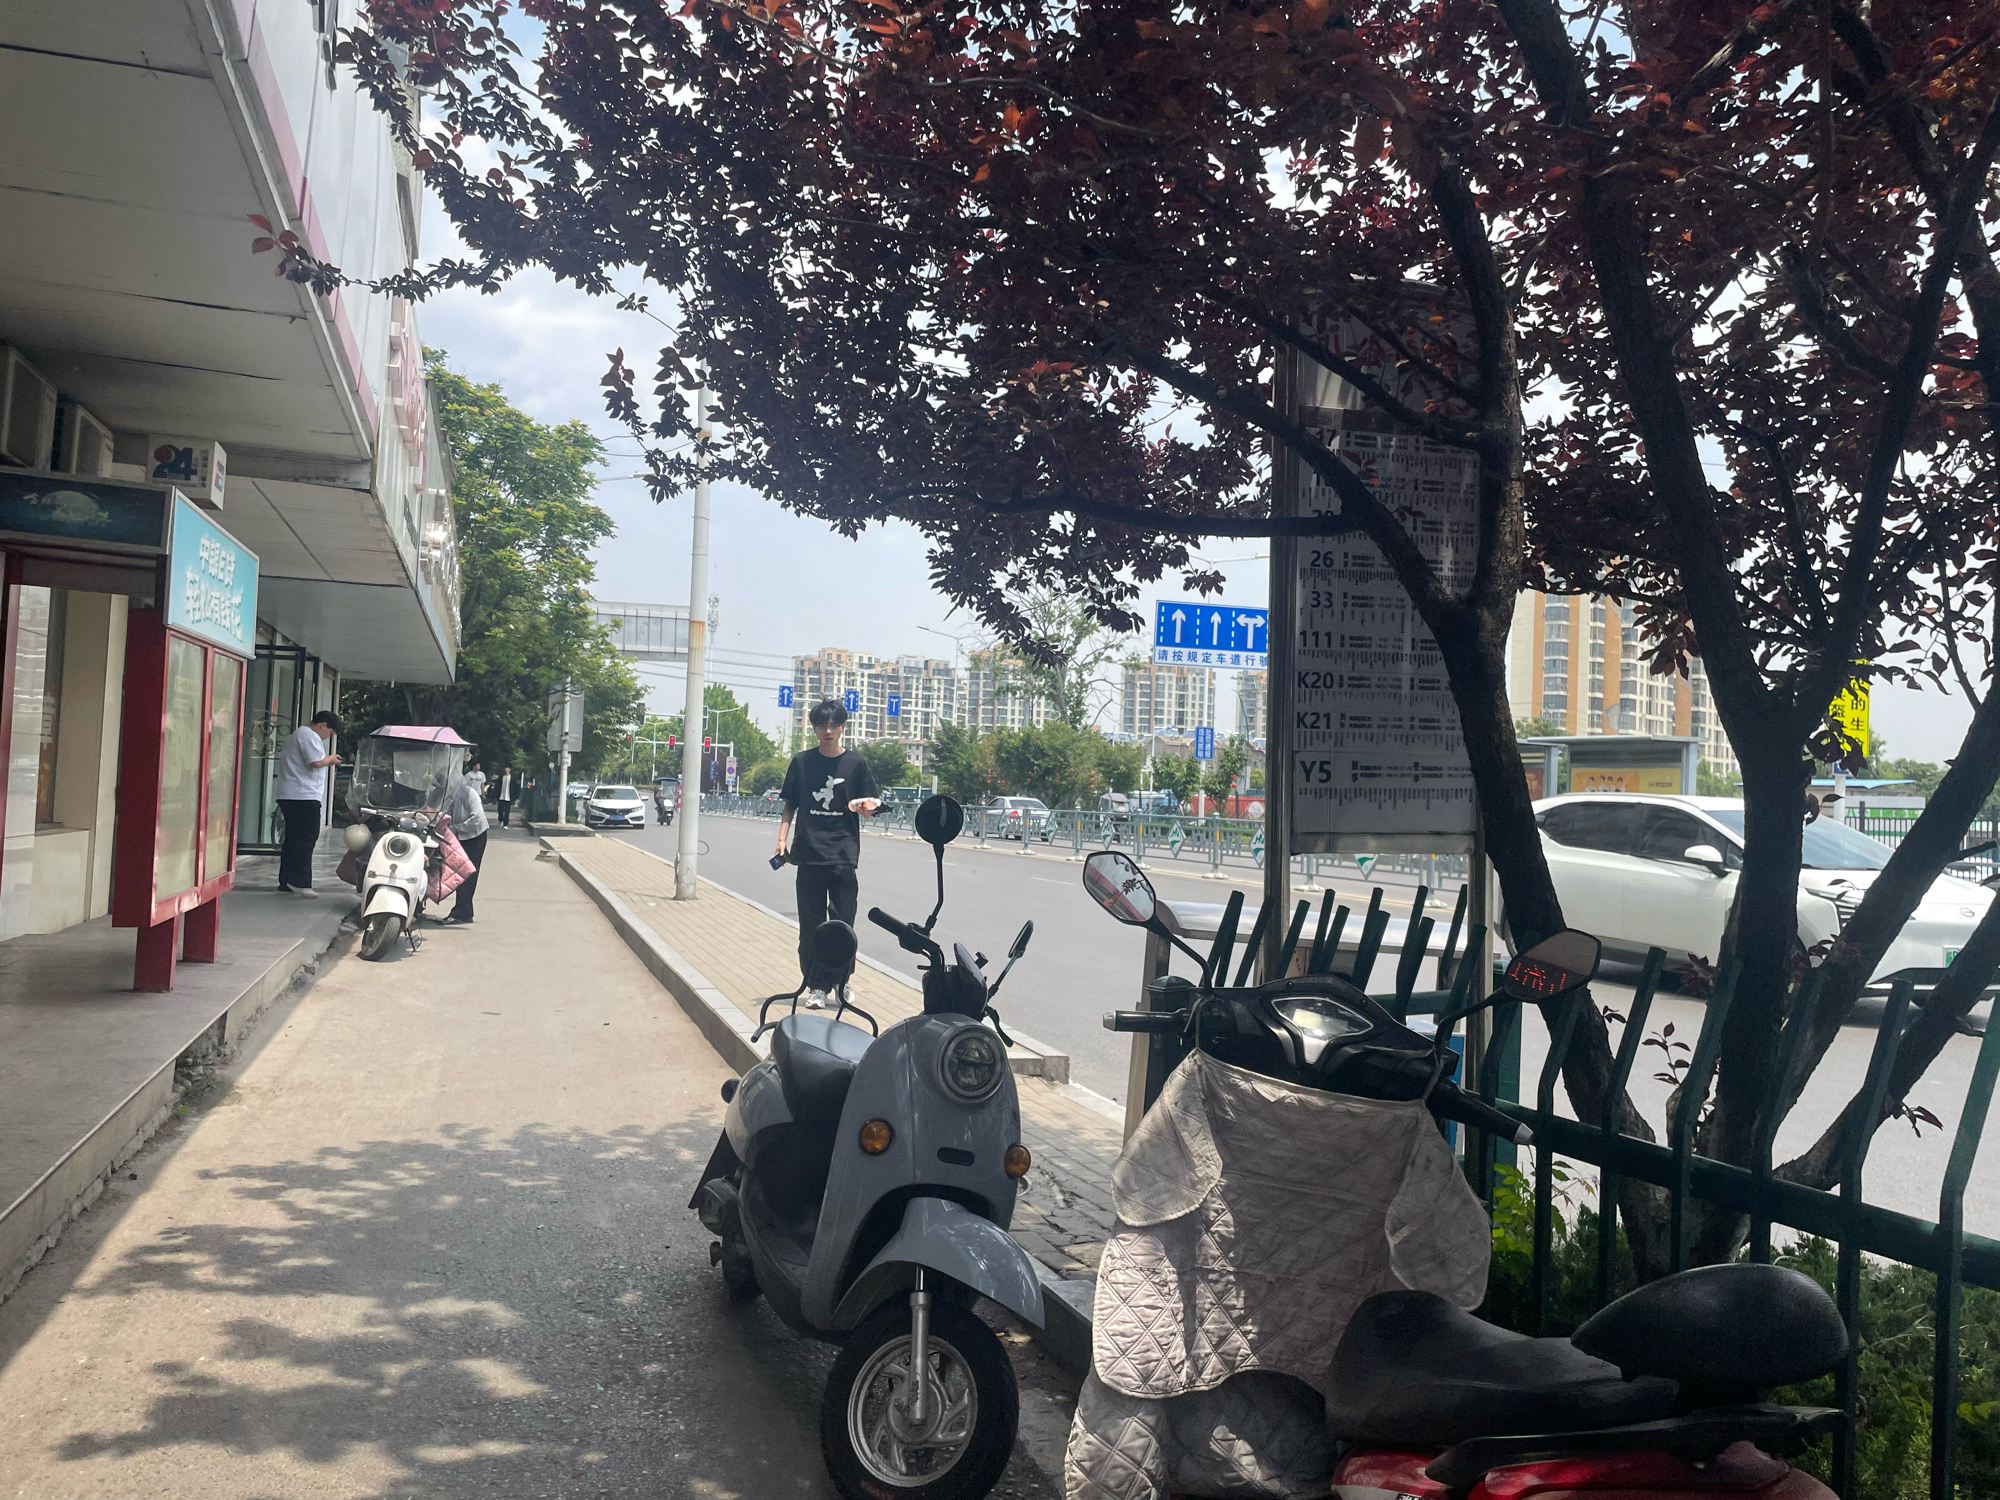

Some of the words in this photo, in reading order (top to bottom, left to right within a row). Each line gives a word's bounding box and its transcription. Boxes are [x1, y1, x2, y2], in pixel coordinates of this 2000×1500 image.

[152, 444, 197, 481] 24
[1310, 550, 1334, 568] 26
[1310, 591, 1334, 608] 33
[1299, 630, 1332, 648] 111
[1157, 649, 1268, 667] 请按规定车道行驶
[1297, 672, 1334, 689] K20
[1296, 712, 1332, 729] K21
[1299, 760, 1332, 783] Y5
